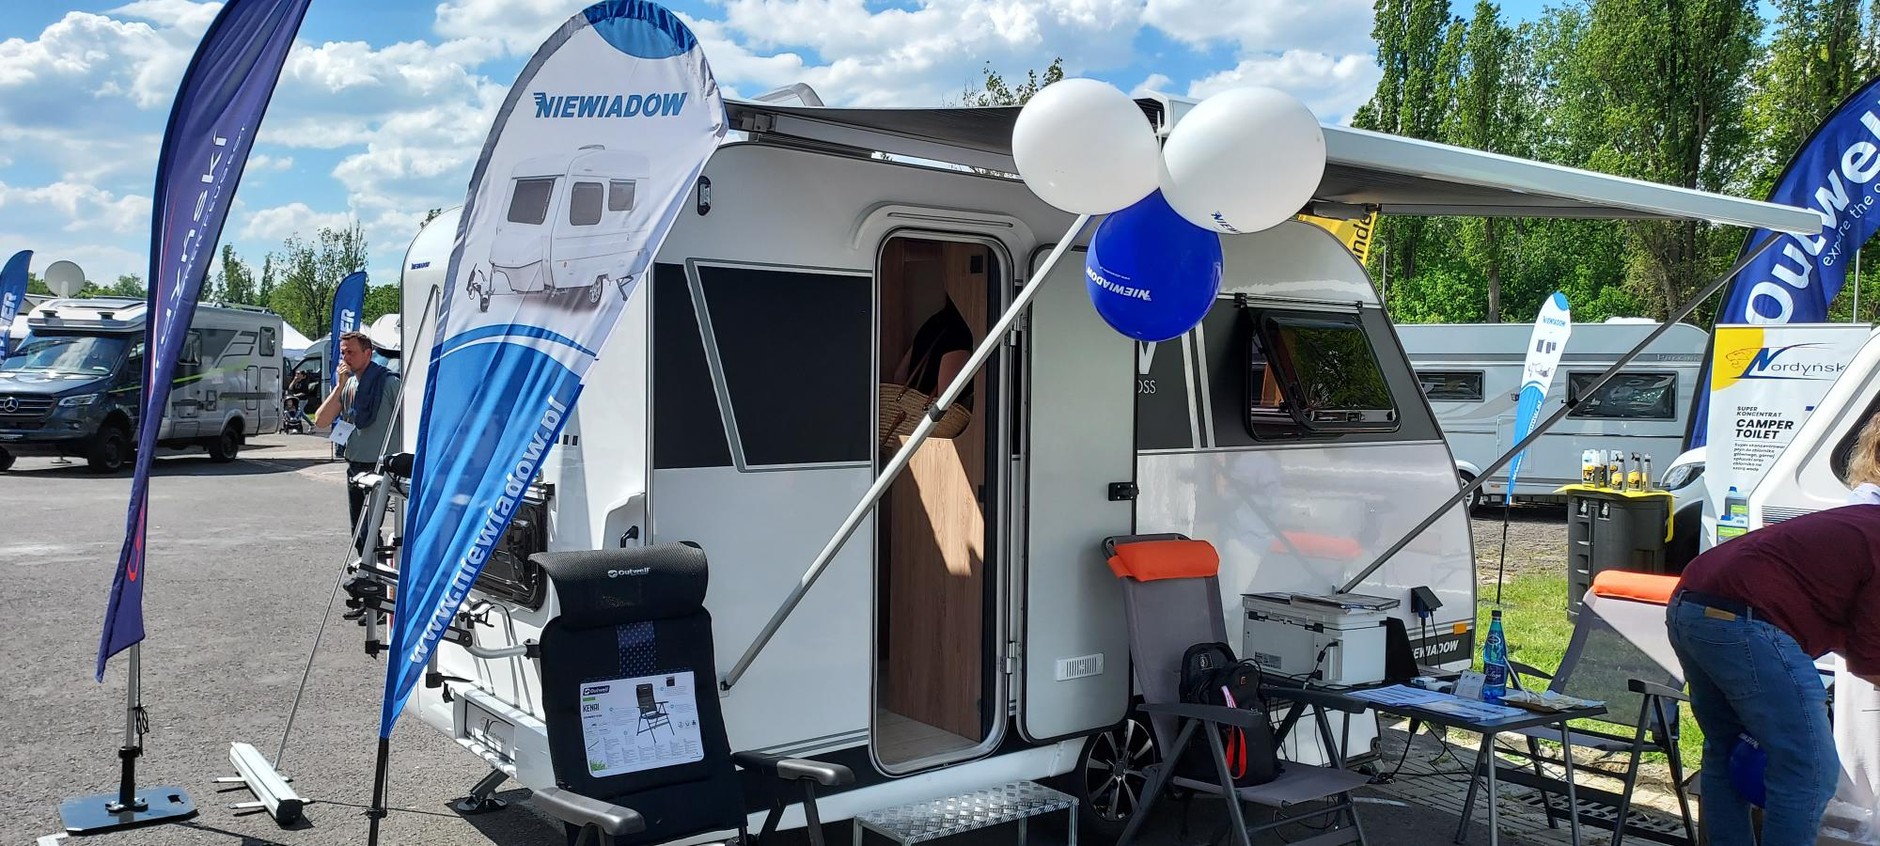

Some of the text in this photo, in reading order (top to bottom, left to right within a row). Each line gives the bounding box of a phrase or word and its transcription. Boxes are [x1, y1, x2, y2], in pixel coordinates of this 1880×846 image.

[1849, 195, 1874, 219] the
[1741, 346, 1846, 379] Nordyńsk
[1735, 429, 1780, 439] TOILET
[1736, 419, 1794, 430] CAMPER
[410, 395, 567, 664] www.niewiadow.pl
